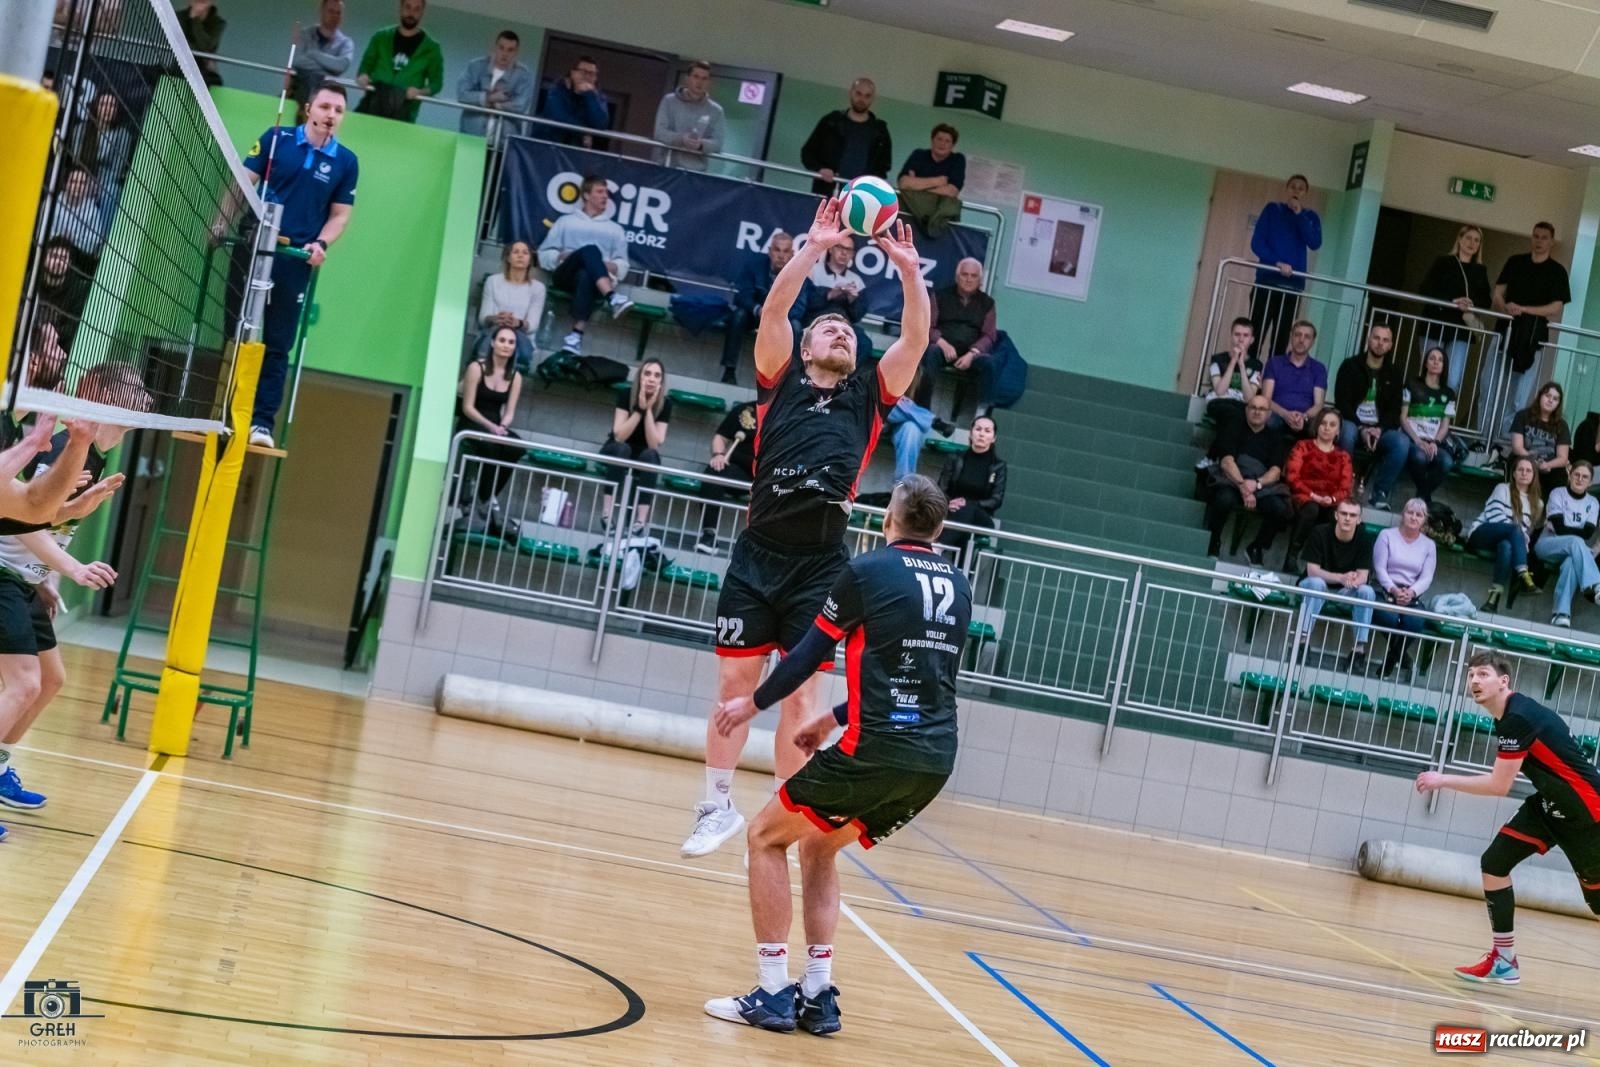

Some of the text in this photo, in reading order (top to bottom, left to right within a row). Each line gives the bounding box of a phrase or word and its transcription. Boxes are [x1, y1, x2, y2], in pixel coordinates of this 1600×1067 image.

[945, 84, 966, 105] F
[982, 90, 998, 111] F
[1351, 158, 1363, 184] F
[1572, 512, 1582, 522] 15
[902, 556, 954, 575] BIADACZ
[914, 572, 956, 625] 12
[716, 616, 745, 645] 22
[925, 630, 947, 640] VOLLEY
